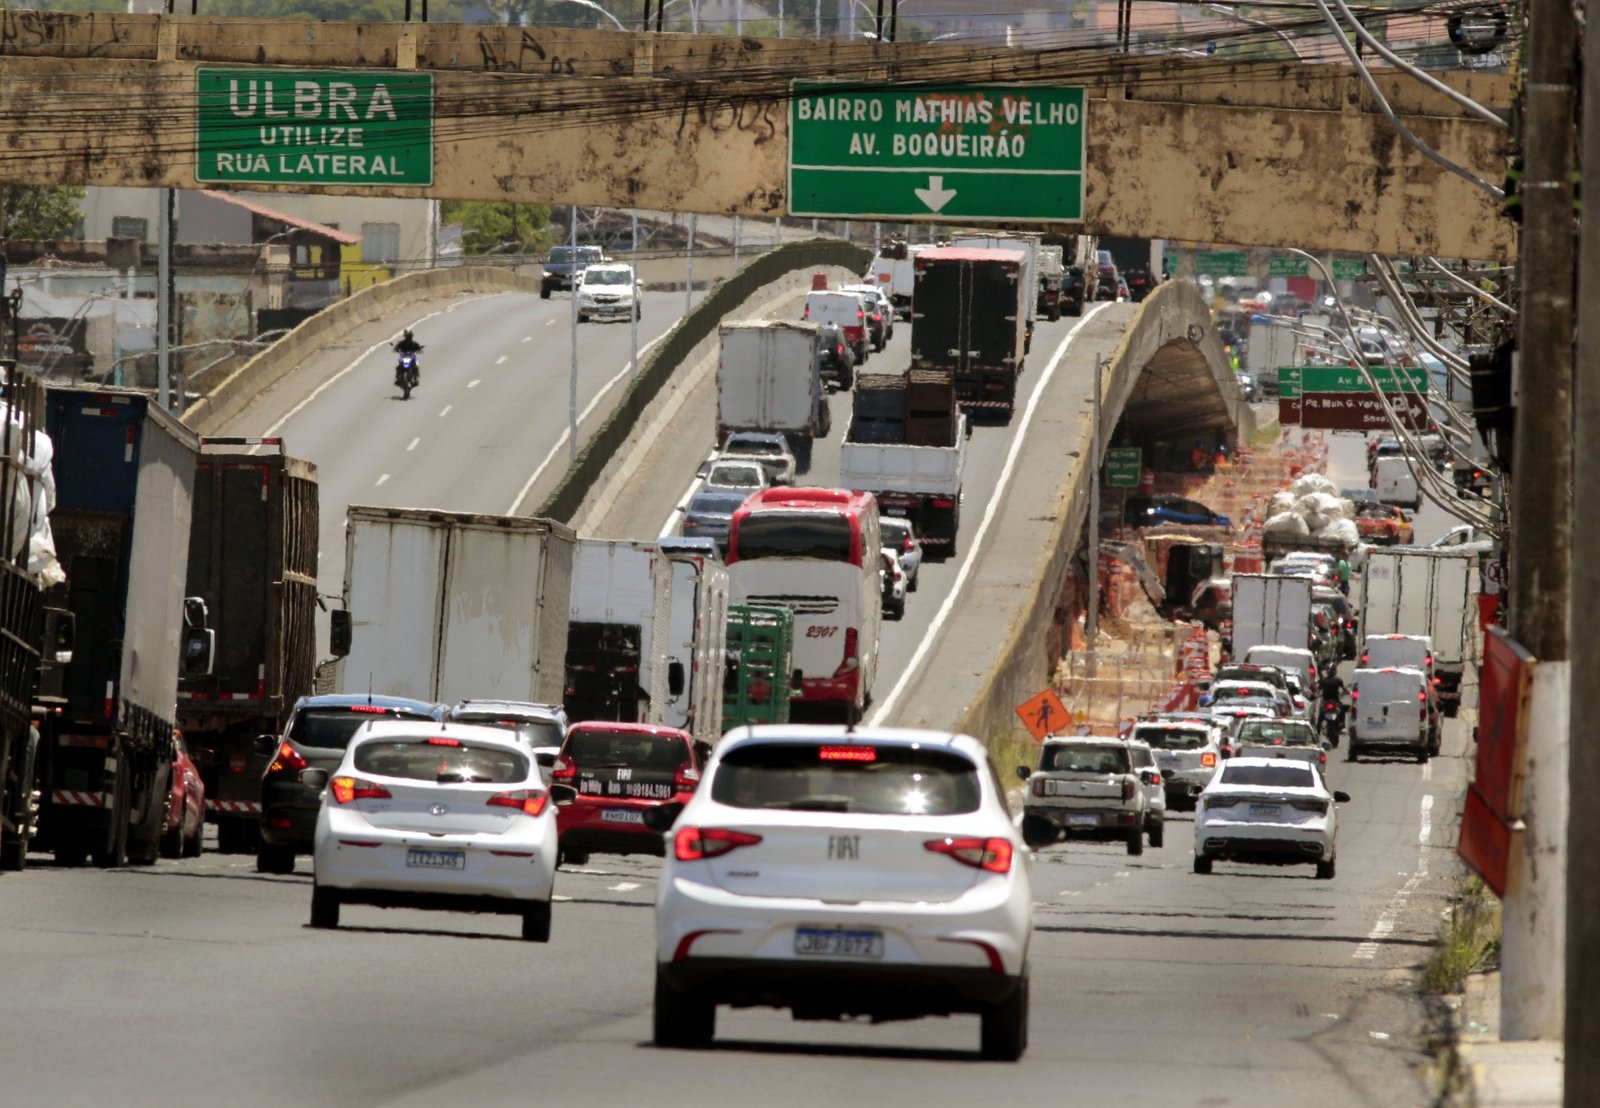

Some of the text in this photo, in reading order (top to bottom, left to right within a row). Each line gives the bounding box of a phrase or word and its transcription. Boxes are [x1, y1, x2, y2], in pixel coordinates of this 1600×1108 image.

[229, 79, 397, 121] ULBRA
[798, 97, 1079, 125] BAIRRO MATHIAS VELHO
[260, 126, 364, 147] UTILIZE
[849, 132, 880, 155] AV.
[216, 152, 405, 176] RUA LATERAL
[805, 625, 839, 638] 2307
[616, 768, 633, 781] FIAT
[827, 835, 862, 860] FIAT
